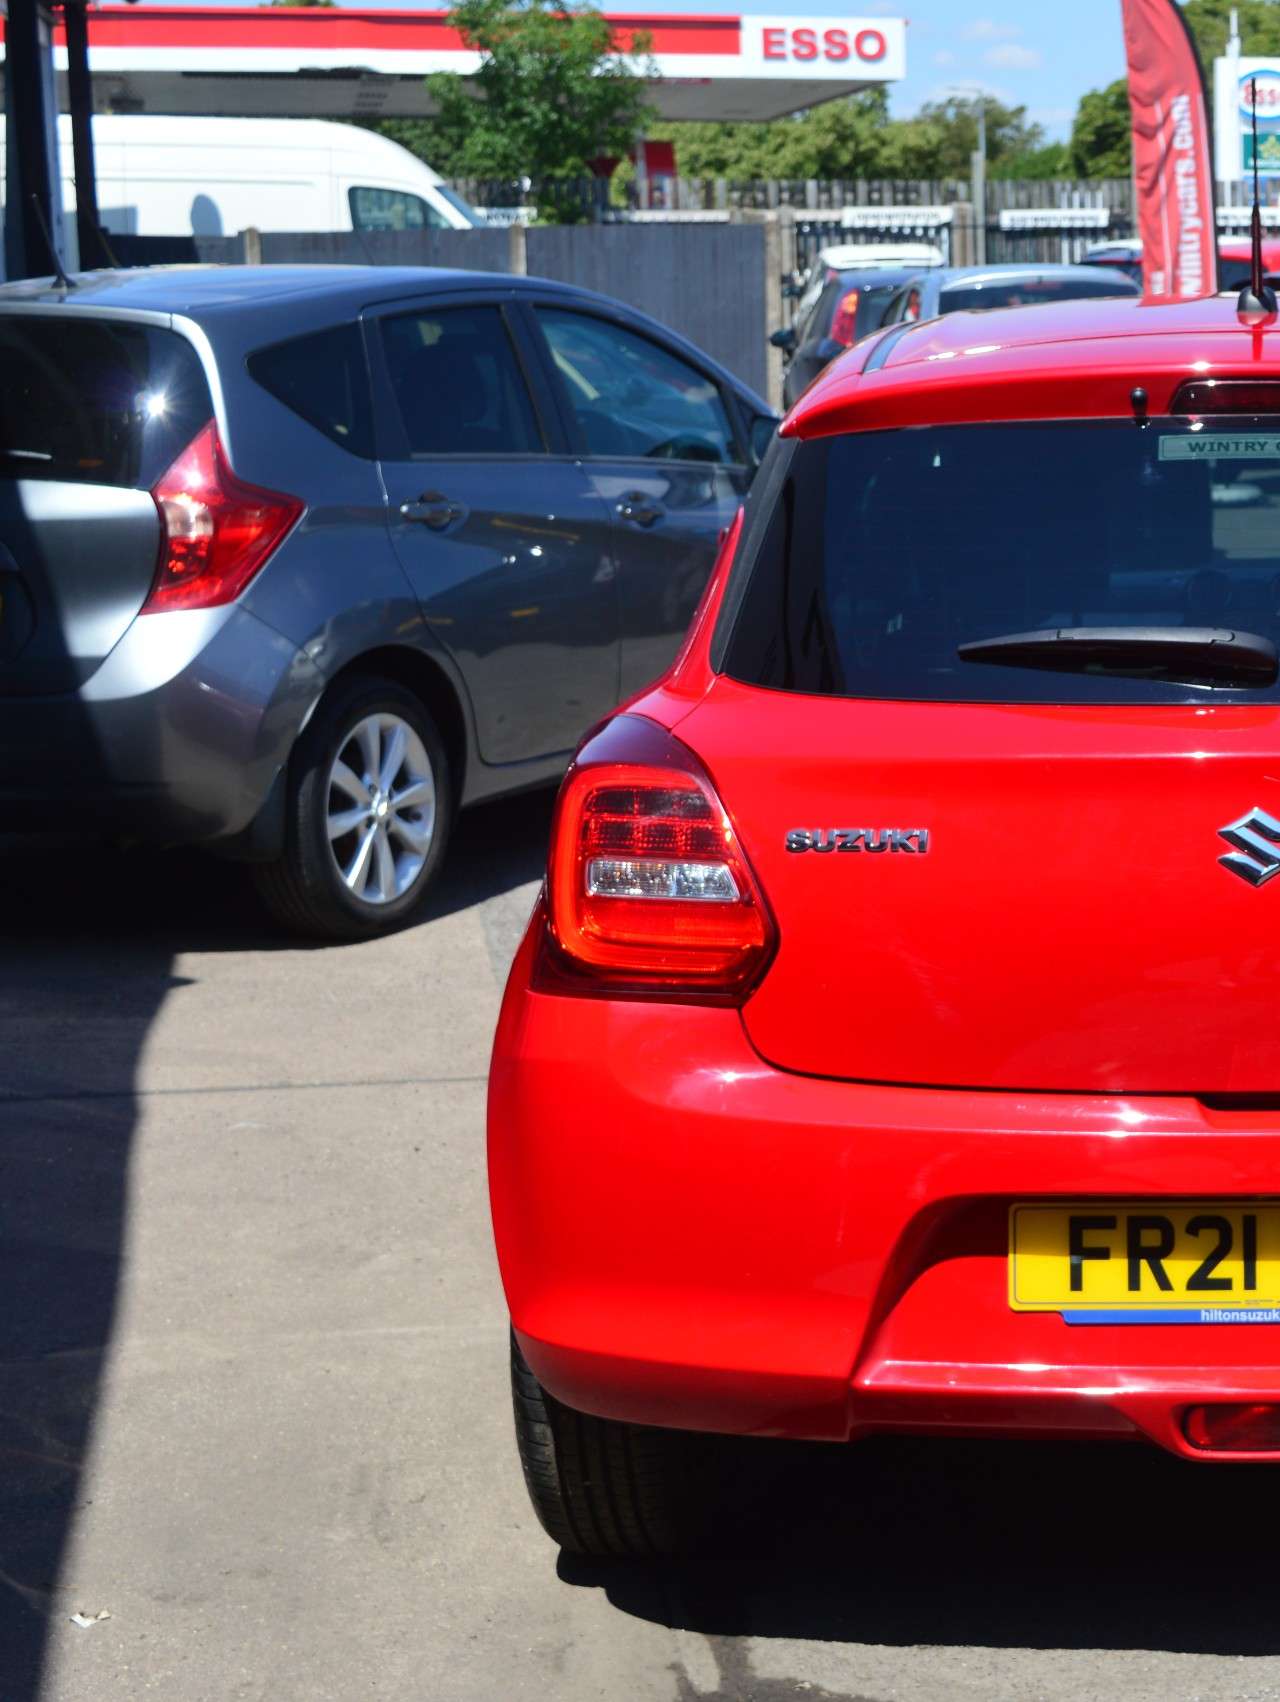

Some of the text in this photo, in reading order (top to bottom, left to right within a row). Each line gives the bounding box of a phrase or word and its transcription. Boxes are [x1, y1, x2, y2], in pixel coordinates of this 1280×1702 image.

[762, 28, 887, 61] ESSO
[1188, 441, 1269, 453] WINTRY
[786, 827, 929, 853] SUZUKI
[1068, 1214, 1257, 1292] FR21
